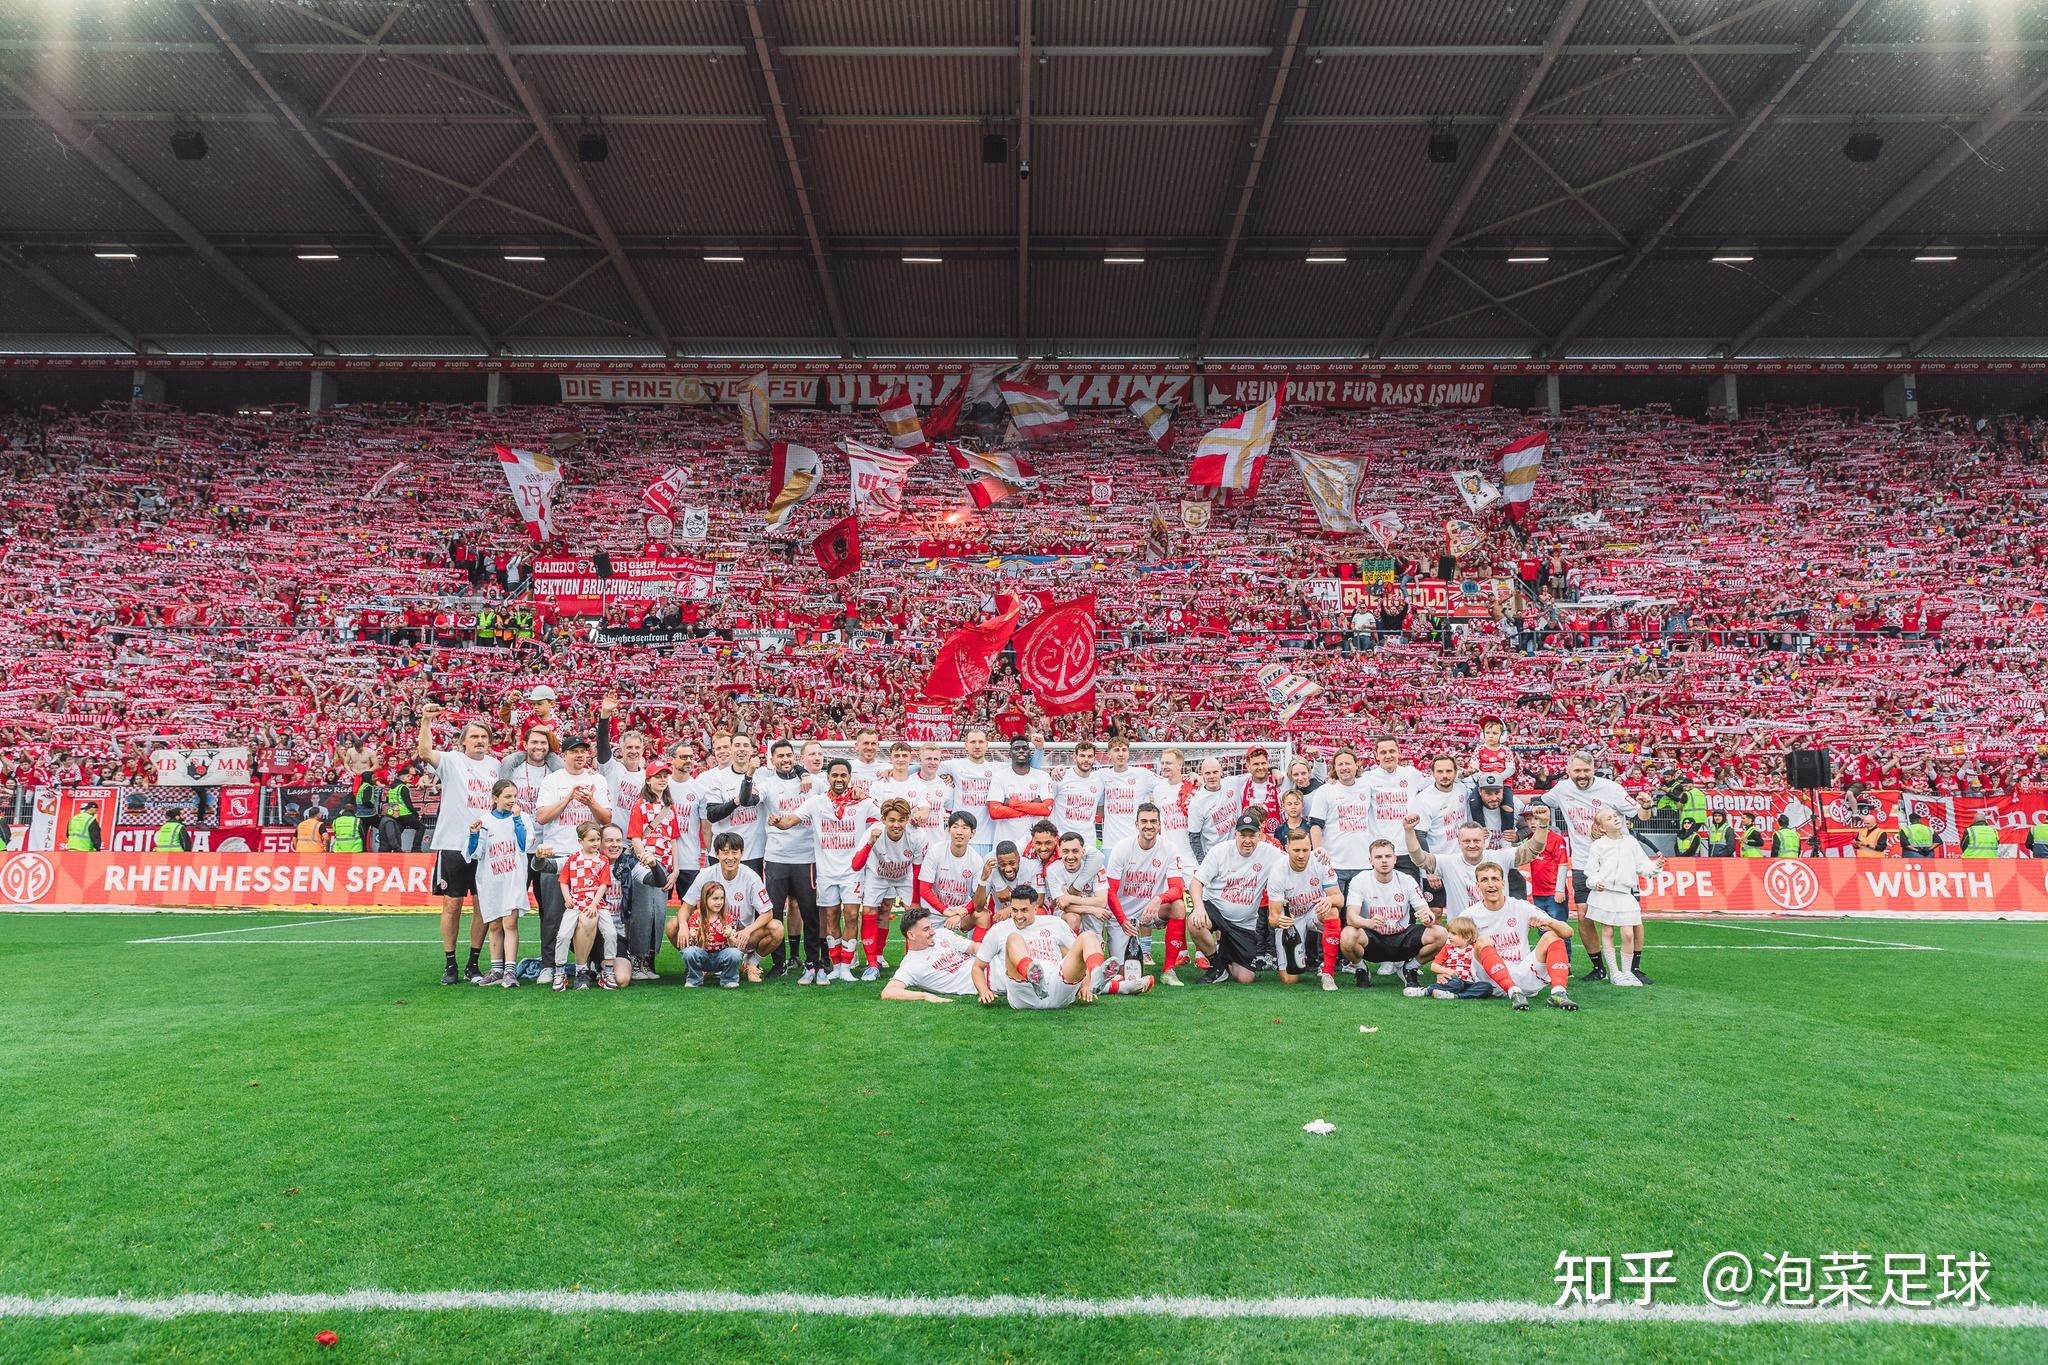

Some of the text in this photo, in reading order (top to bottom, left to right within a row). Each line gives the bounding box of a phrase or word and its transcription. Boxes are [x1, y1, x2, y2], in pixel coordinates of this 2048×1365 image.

[566, 380, 813, 398] DIE FANS FSV
[1047, 375, 1191, 406] MAINZ
[1235, 379, 1484, 405] KEIN PLATZ FÜR RASS ISMUS
[533, 579, 580, 595] SEKTION
[582, 579, 641, 596] BRUCHWEG
[104, 864, 333, 892] RHEINHESSEN
[1865, 863, 1994, 899] WÜRTH
